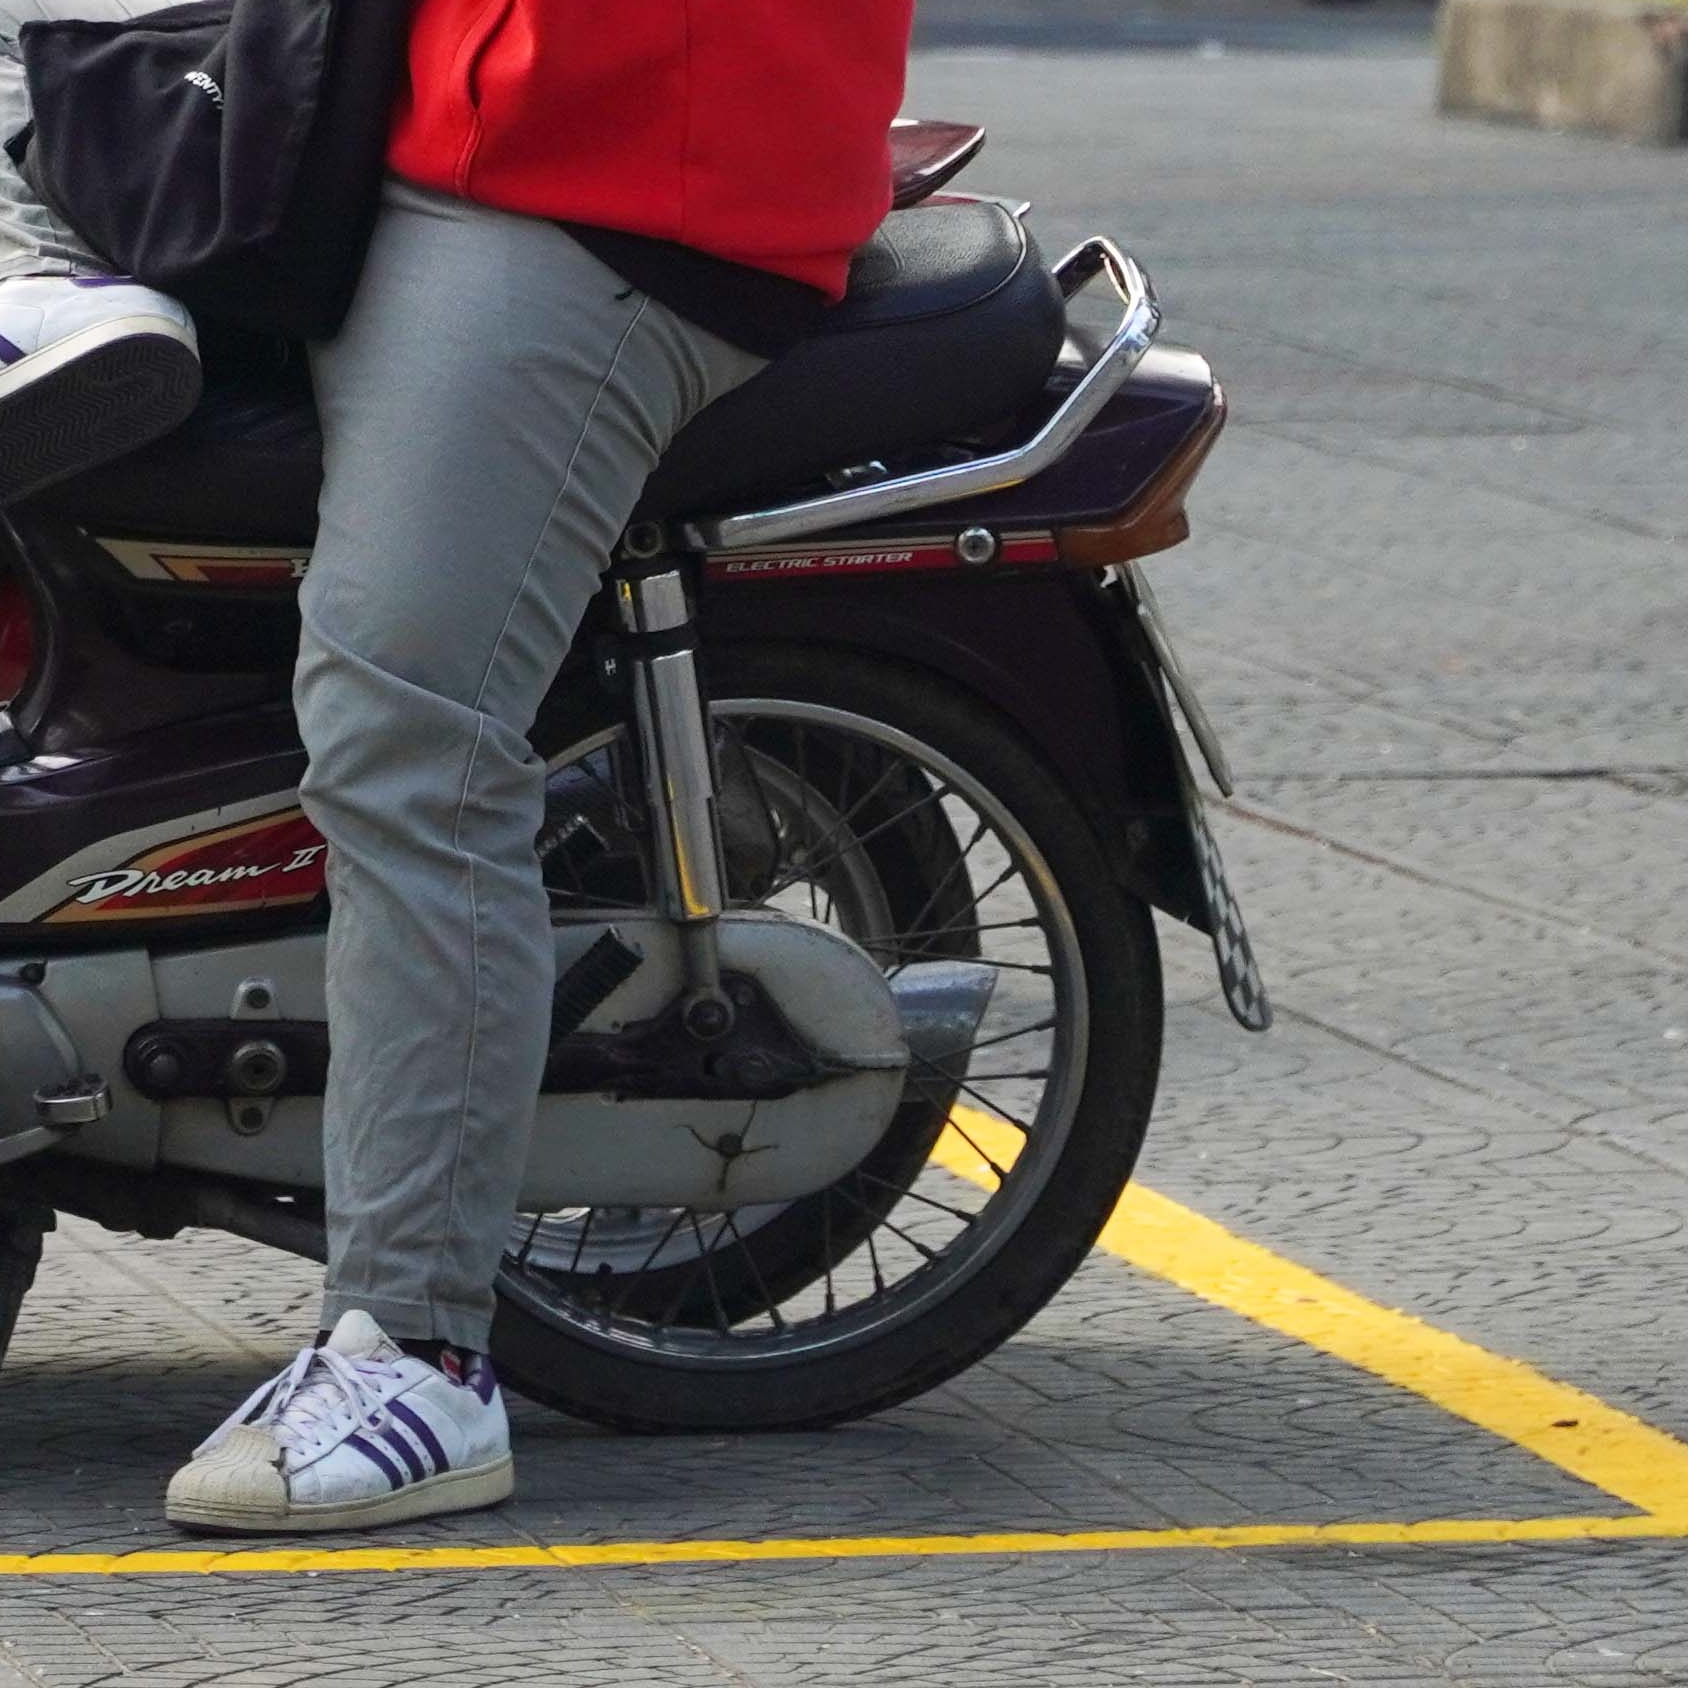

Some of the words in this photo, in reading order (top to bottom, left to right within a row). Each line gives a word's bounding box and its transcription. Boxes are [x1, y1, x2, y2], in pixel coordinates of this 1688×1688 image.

[726, 557, 817, 573] ELECTRIC
[823, 552, 913, 567] STARTER
[68, 863, 281, 904] Dream
